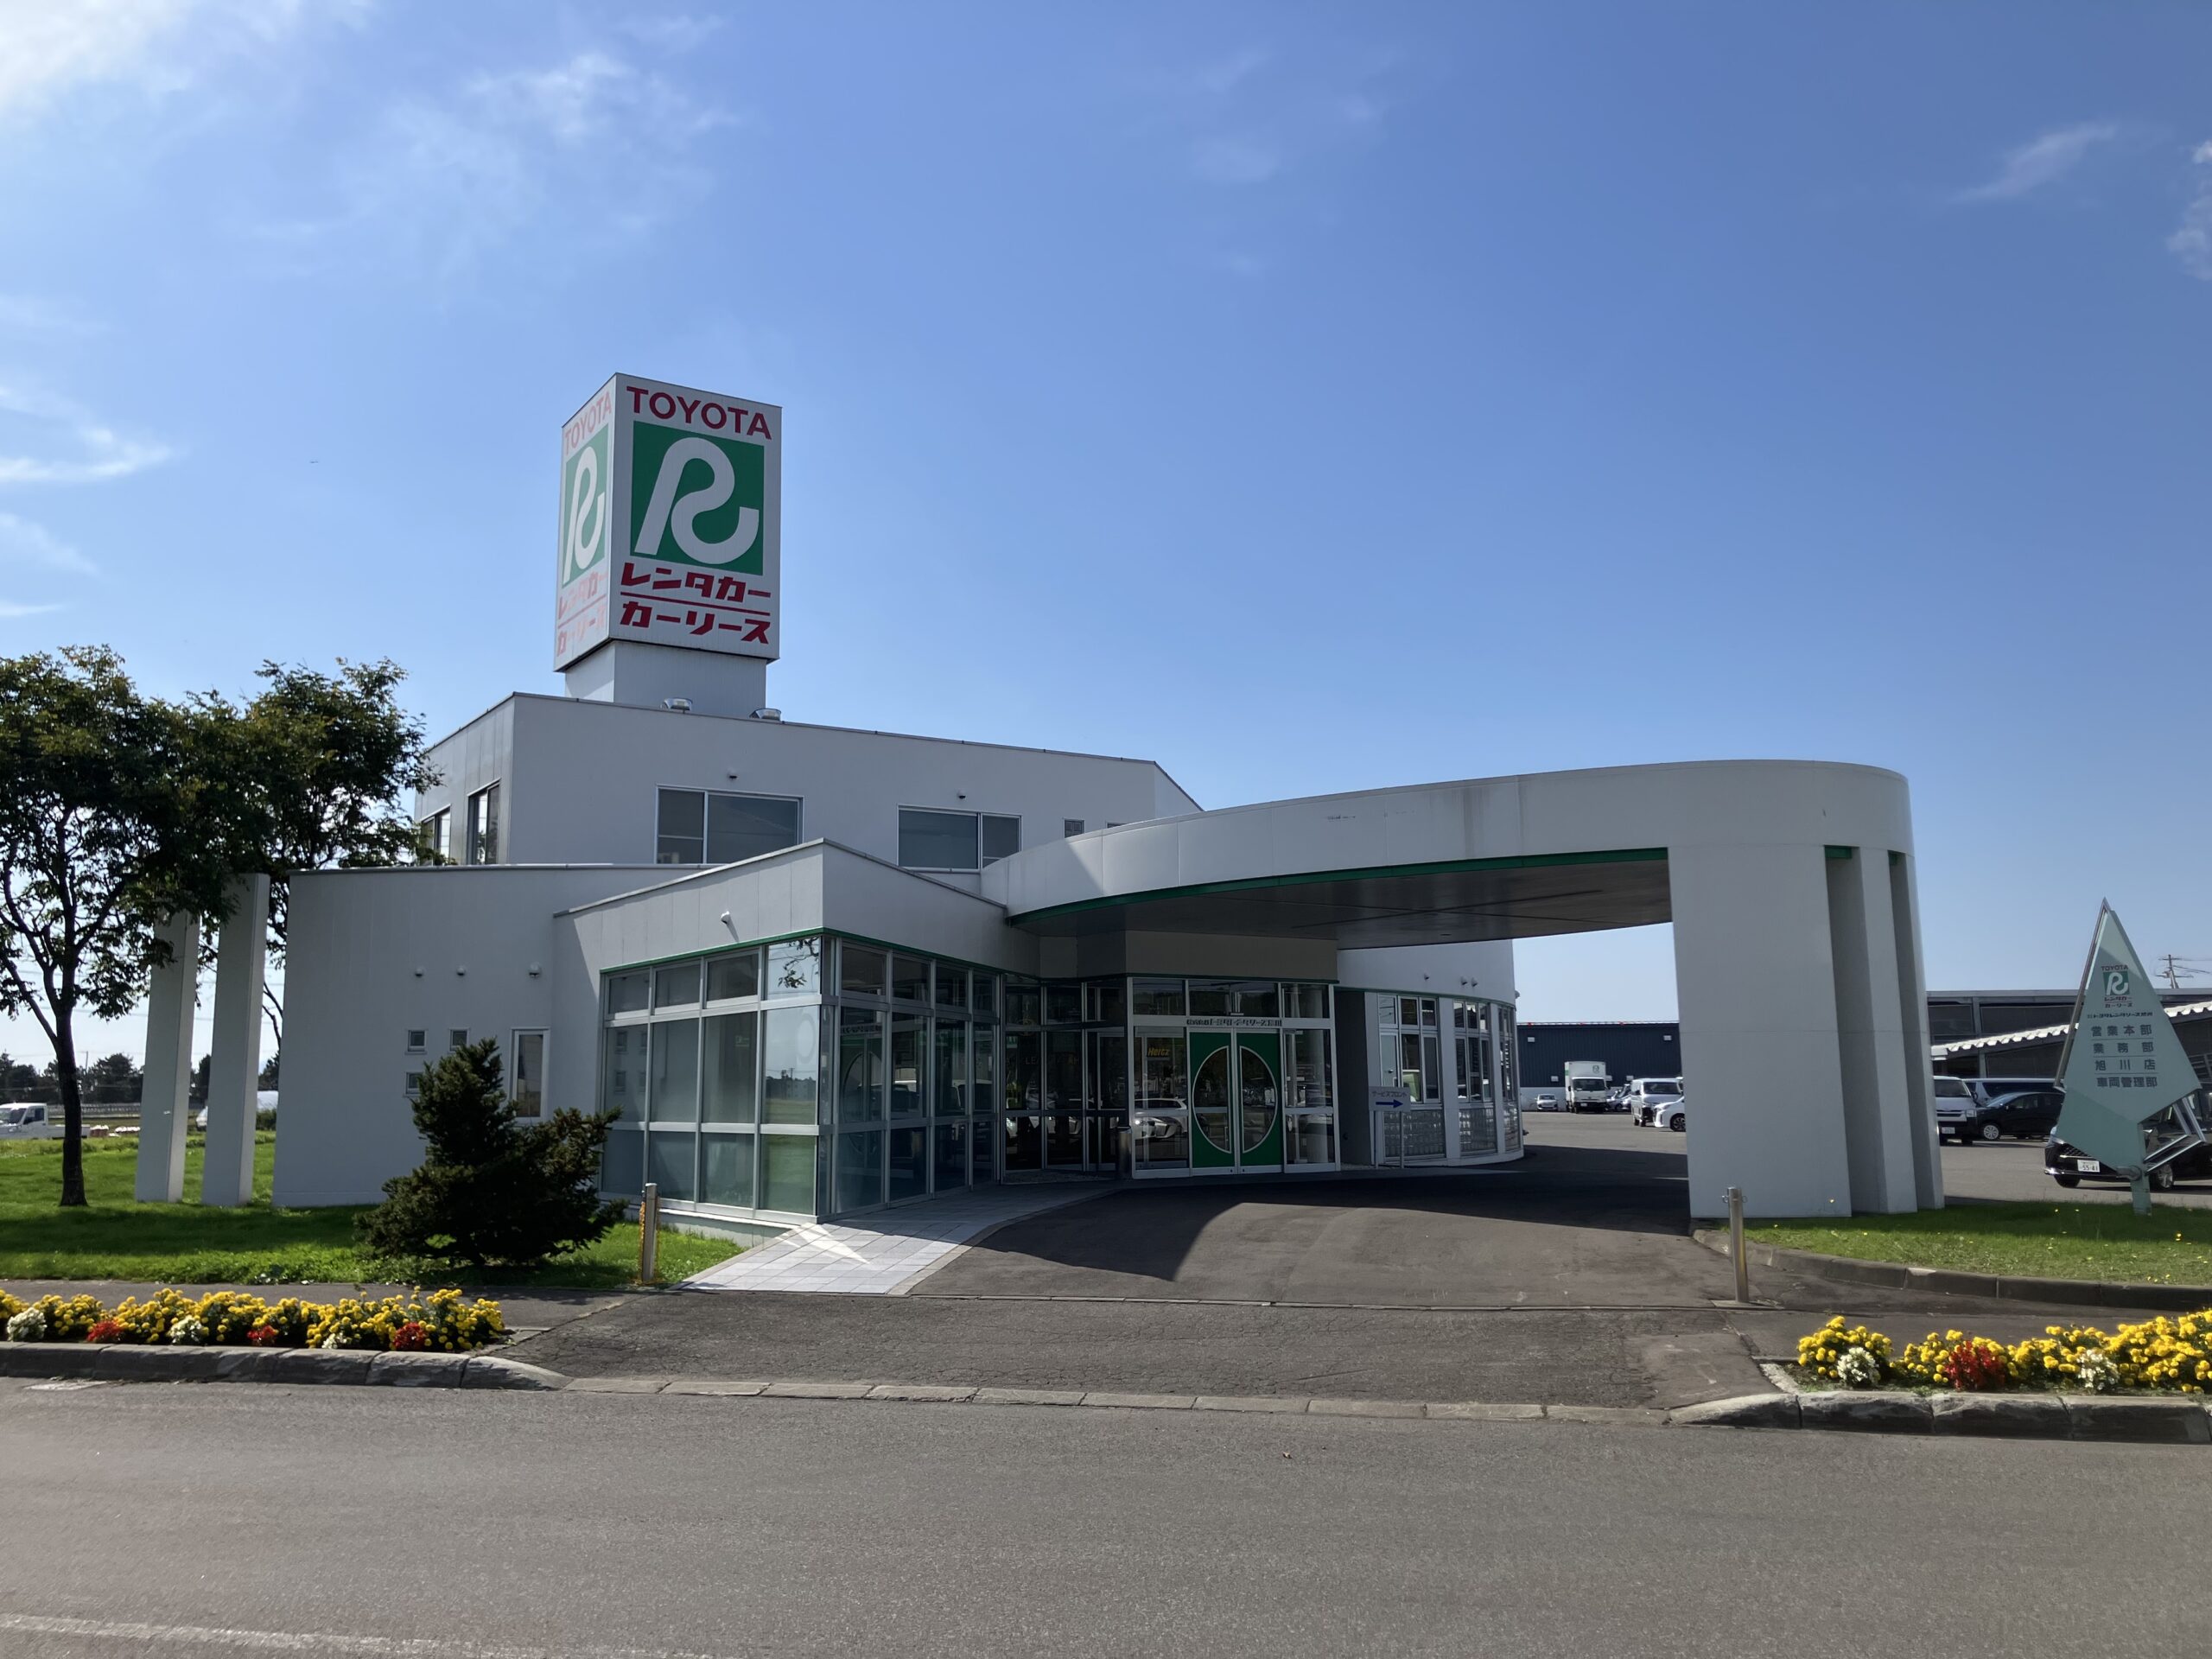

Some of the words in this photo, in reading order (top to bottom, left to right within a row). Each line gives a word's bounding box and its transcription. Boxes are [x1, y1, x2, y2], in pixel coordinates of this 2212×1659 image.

[626, 385, 772, 441] TOYOTA
[565, 391, 613, 455] TOYOTA
[620, 562, 772, 603] レンタカー
[620, 601, 772, 645] カーリース
[2091, 1024, 2152, 1037] 営業本部
[1147, 1047, 1170, 1057] Hertz
[2093, 1041, 2154, 1053] 業務部
[2094, 1058, 2156, 1071] 旭川店
[2096, 1077, 2158, 1088] 車両管理部
